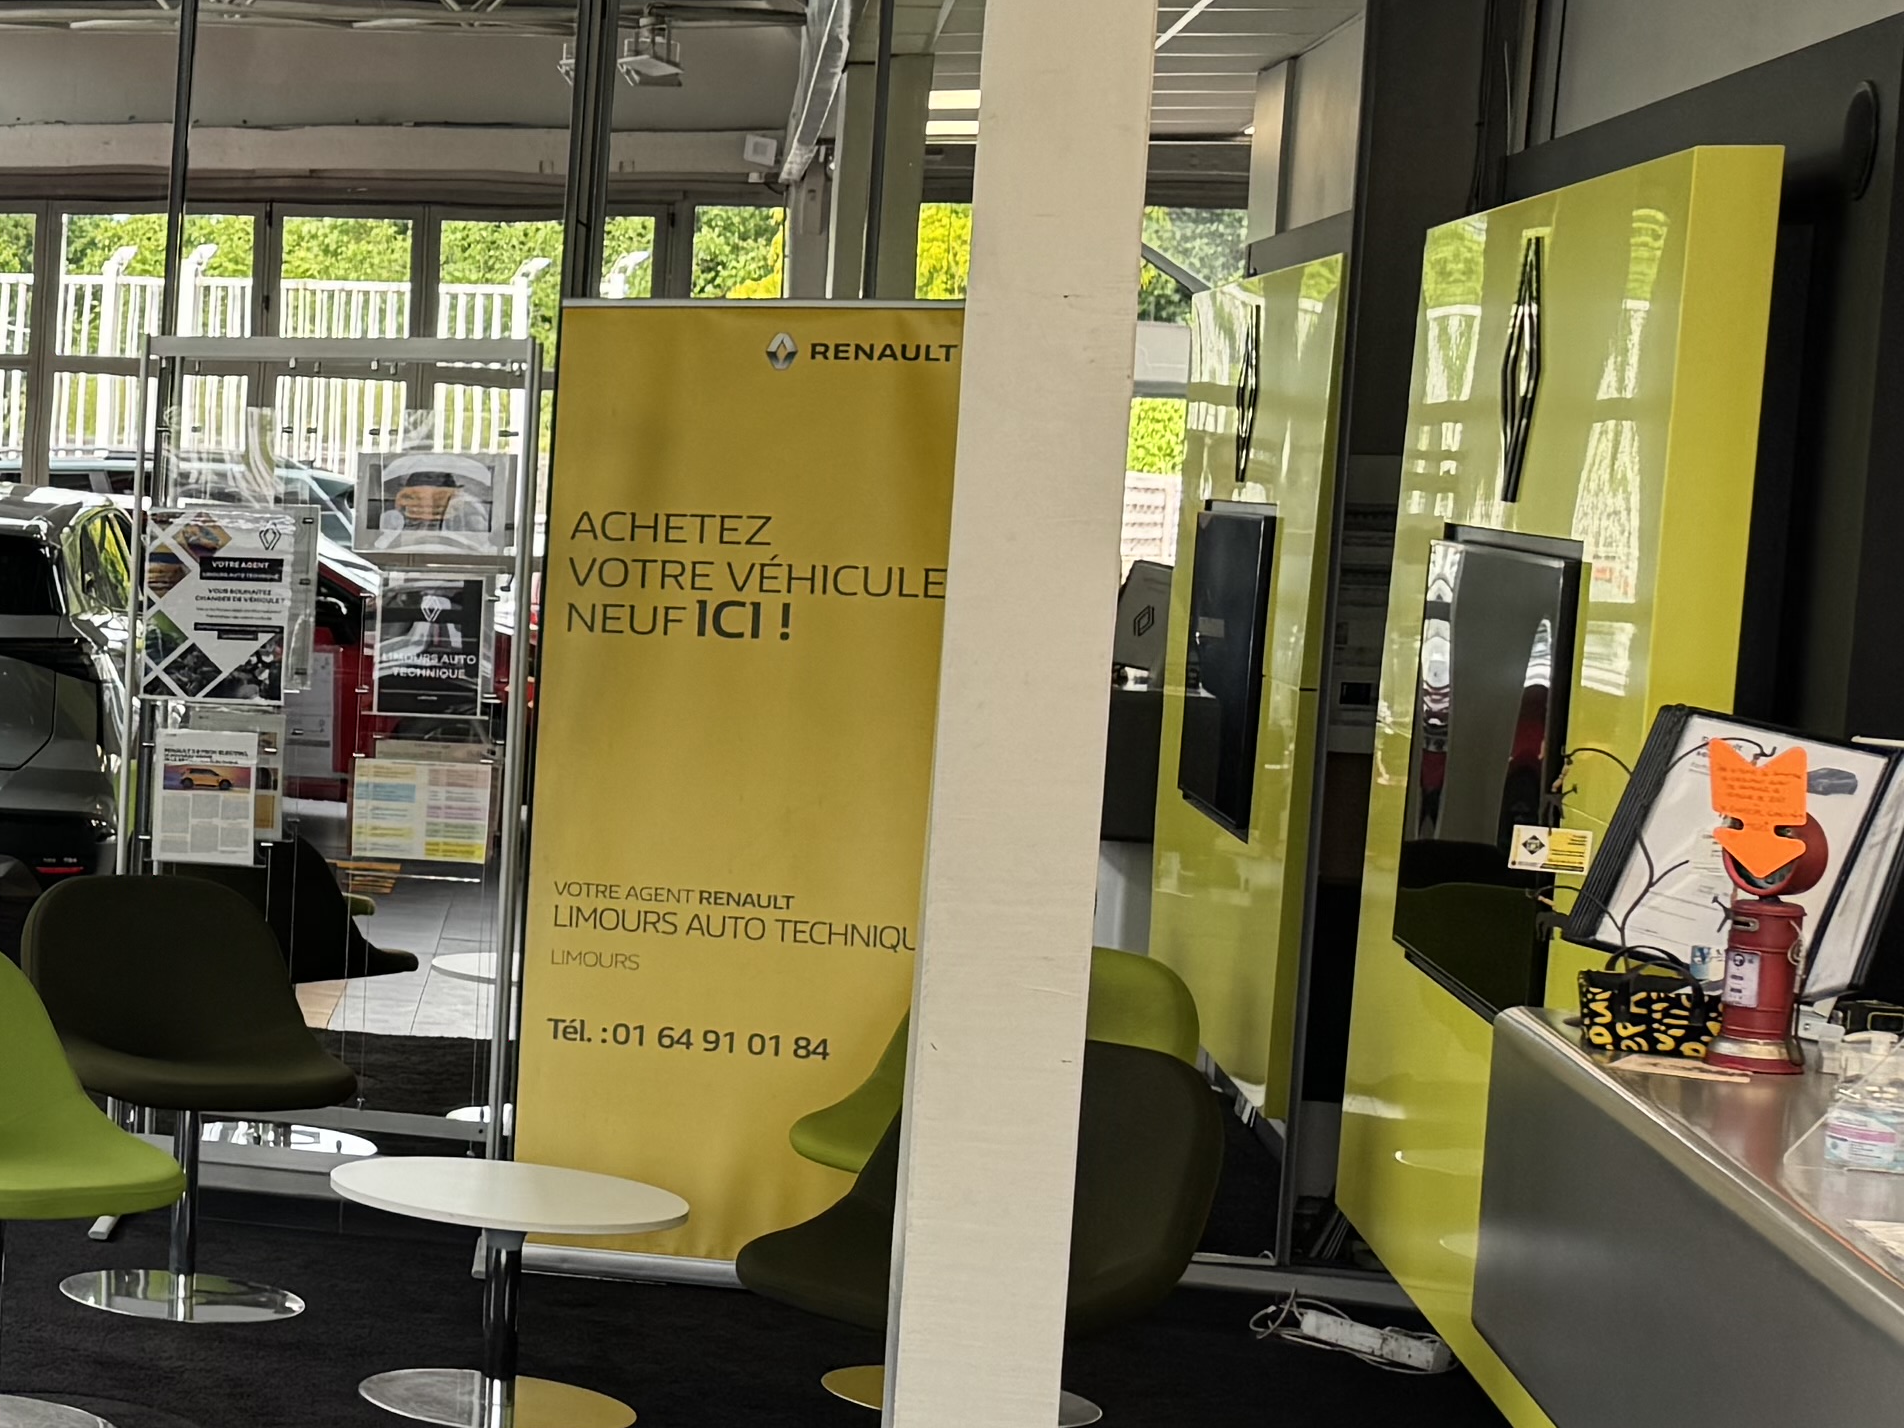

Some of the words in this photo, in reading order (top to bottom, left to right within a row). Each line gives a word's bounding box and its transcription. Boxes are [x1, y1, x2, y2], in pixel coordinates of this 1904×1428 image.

[810, 342, 958, 362] RENAULT
[570, 511, 773, 546] ACHETEZ
[569, 556, 715, 591] VOTRE
[727, 554, 947, 601] VÉHICULE
[567, 602, 687, 636] NEUF
[696, 599, 761, 639] ICI
[779, 602, 791, 640] !
[393, 667, 466, 679] TECHNIQUE
[441, 654, 476, 665] AUTO
[553, 881, 621, 900] VOTRE
[624, 885, 695, 905] AGENT
[698, 889, 795, 910] RENAULT
[553, 904, 678, 936] LIMOURS
[685, 913, 766, 942] AUTO
[550, 949, 640, 971] LIMOURS
[546, 1017, 592, 1043] Tél.
[657, 1026, 694, 1051] 64
[702, 1029, 737, 1054] 91
[747, 1033, 781, 1057] 01
[792, 1036, 830, 1061] 84
